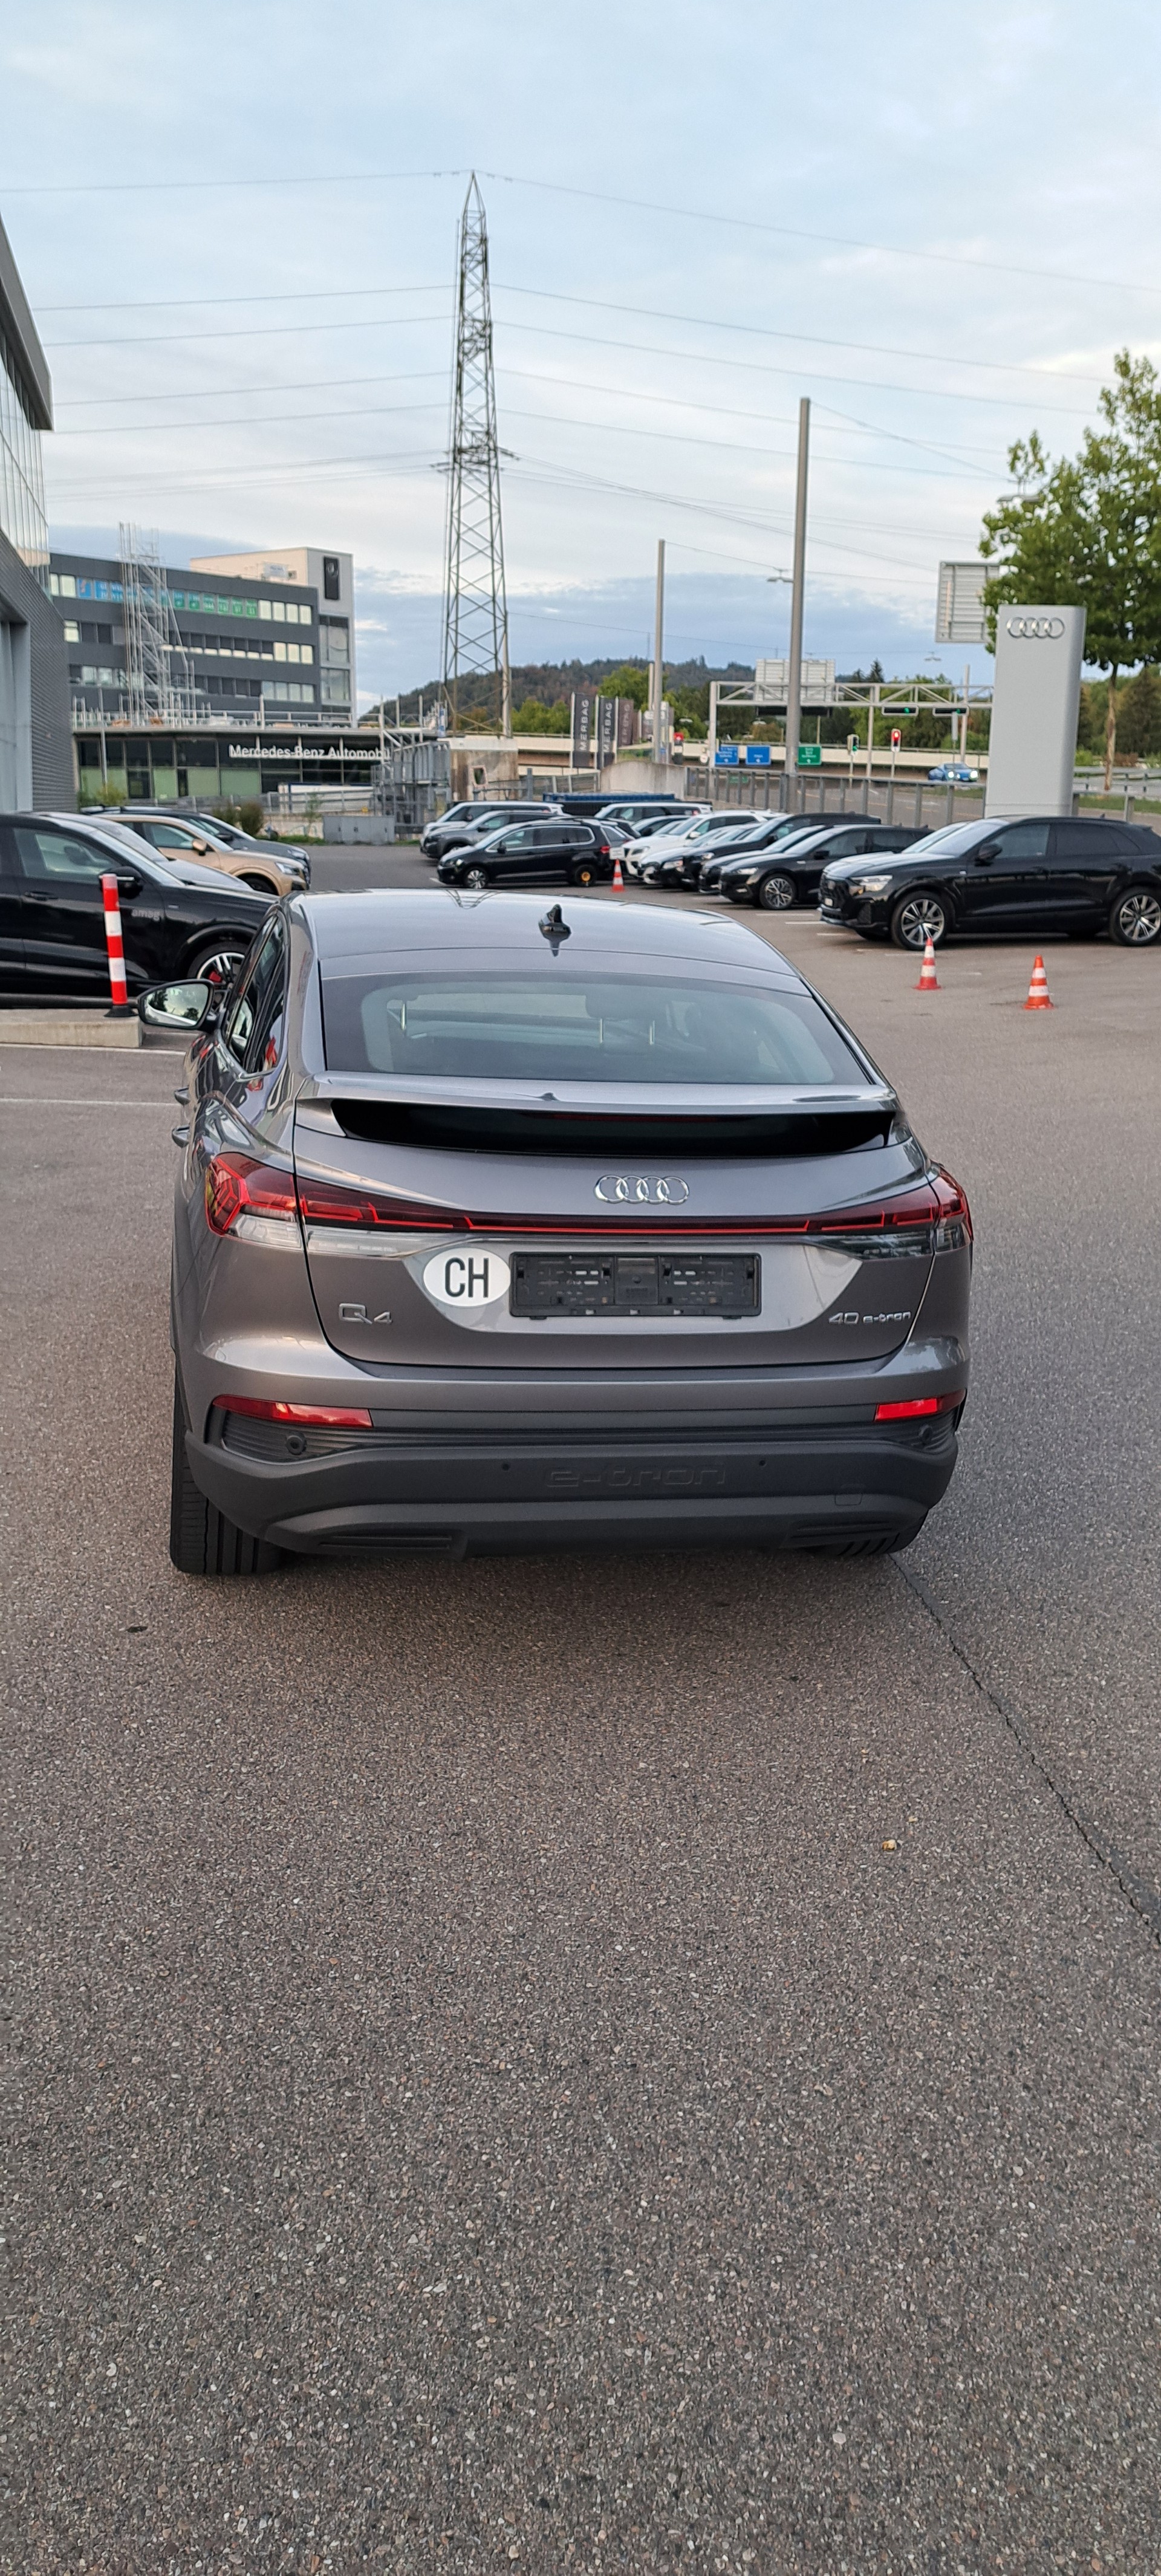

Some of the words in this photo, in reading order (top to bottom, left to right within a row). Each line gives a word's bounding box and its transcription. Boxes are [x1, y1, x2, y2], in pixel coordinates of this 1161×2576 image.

[579, 699, 590, 750] MERBAG
[603, 702, 613, 752] MERBAG
[229, 744, 325, 758] Mercedes-Benz
[444, 1257, 489, 1298] CH
[338, 1303, 392, 1324] Q4
[828, 1312, 859, 1324] 40
[863, 1311, 911, 1324] e-tron
[545, 1465, 726, 1488] e-tron
